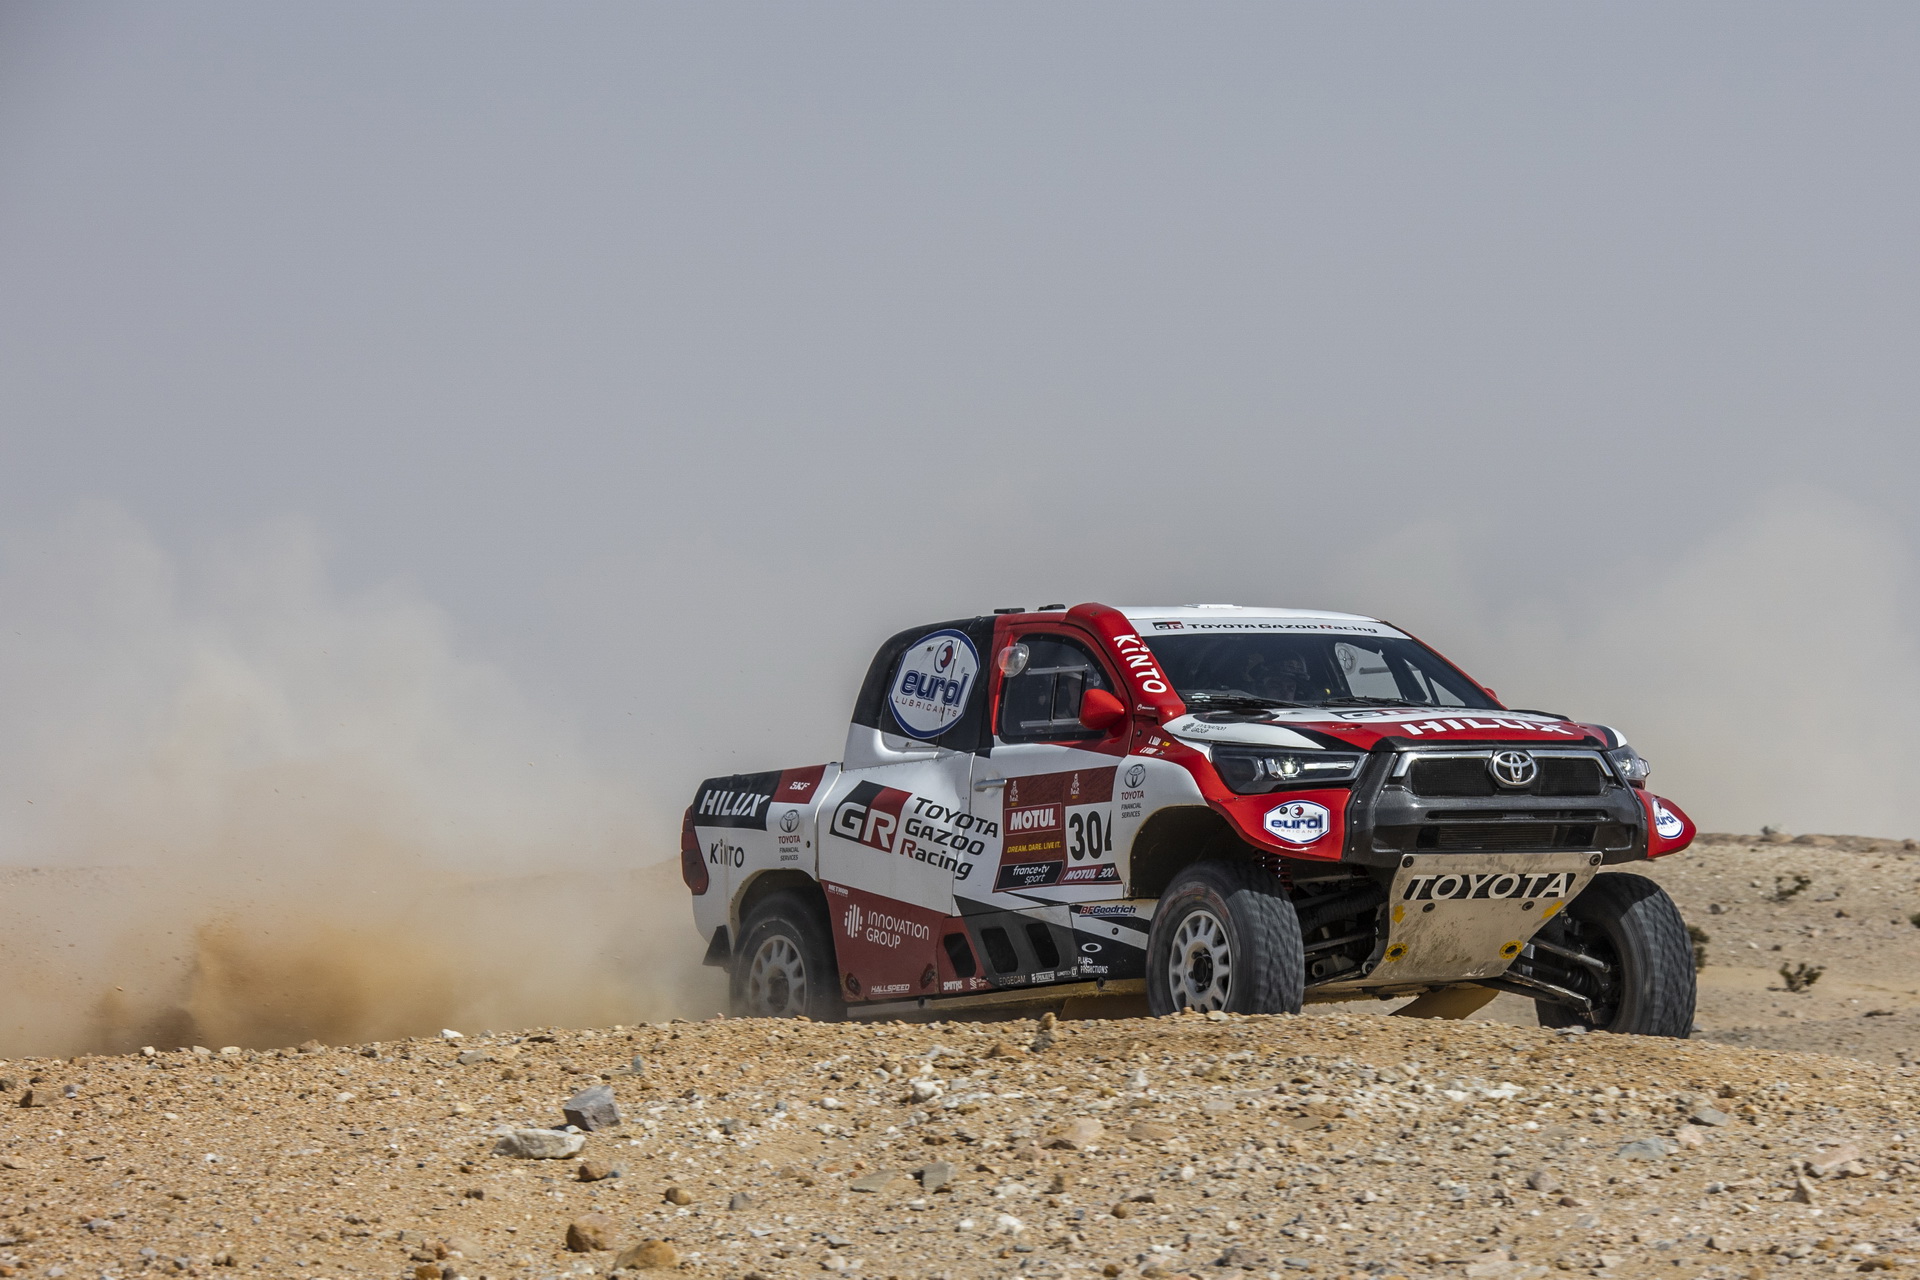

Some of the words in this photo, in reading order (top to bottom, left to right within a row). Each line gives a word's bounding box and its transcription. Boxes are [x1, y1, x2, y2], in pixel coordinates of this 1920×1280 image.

[1319, 624, 1378, 633] Racing
[900, 670, 969, 707] eurol
[895, 696, 957, 717] LUBRICANTS
[1401, 718, 1574, 735] HILUX
[789, 781, 810, 791] SKF
[1121, 790, 1145, 800] TOYOTA
[699, 790, 770, 817] HILUX
[1121, 802, 1142, 811] FINANCIAL
[914, 797, 999, 838] TOYOTA
[1010, 808, 1055, 831] MOTUL
[1121, 811, 1141, 819] SERVICES
[1271, 814, 1324, 829] eurol
[834, 801, 897, 849] GR
[778, 835, 800, 845] TOYOTA
[905, 818, 985, 856] GAZOO
[900, 838, 973, 881] Racing
[1024, 874, 1045, 885] sport
[1064, 868, 1097, 880] MOTUL
[1098, 867, 1115, 878] 300
[1409, 873, 1568, 900] TOYOTA
[1079, 905, 1137, 915] BFGoodrich
[866, 928, 901, 949] GROUP
[999, 974, 1026, 986] EDGECAM
[871, 984, 910, 993] HALLSPEED
